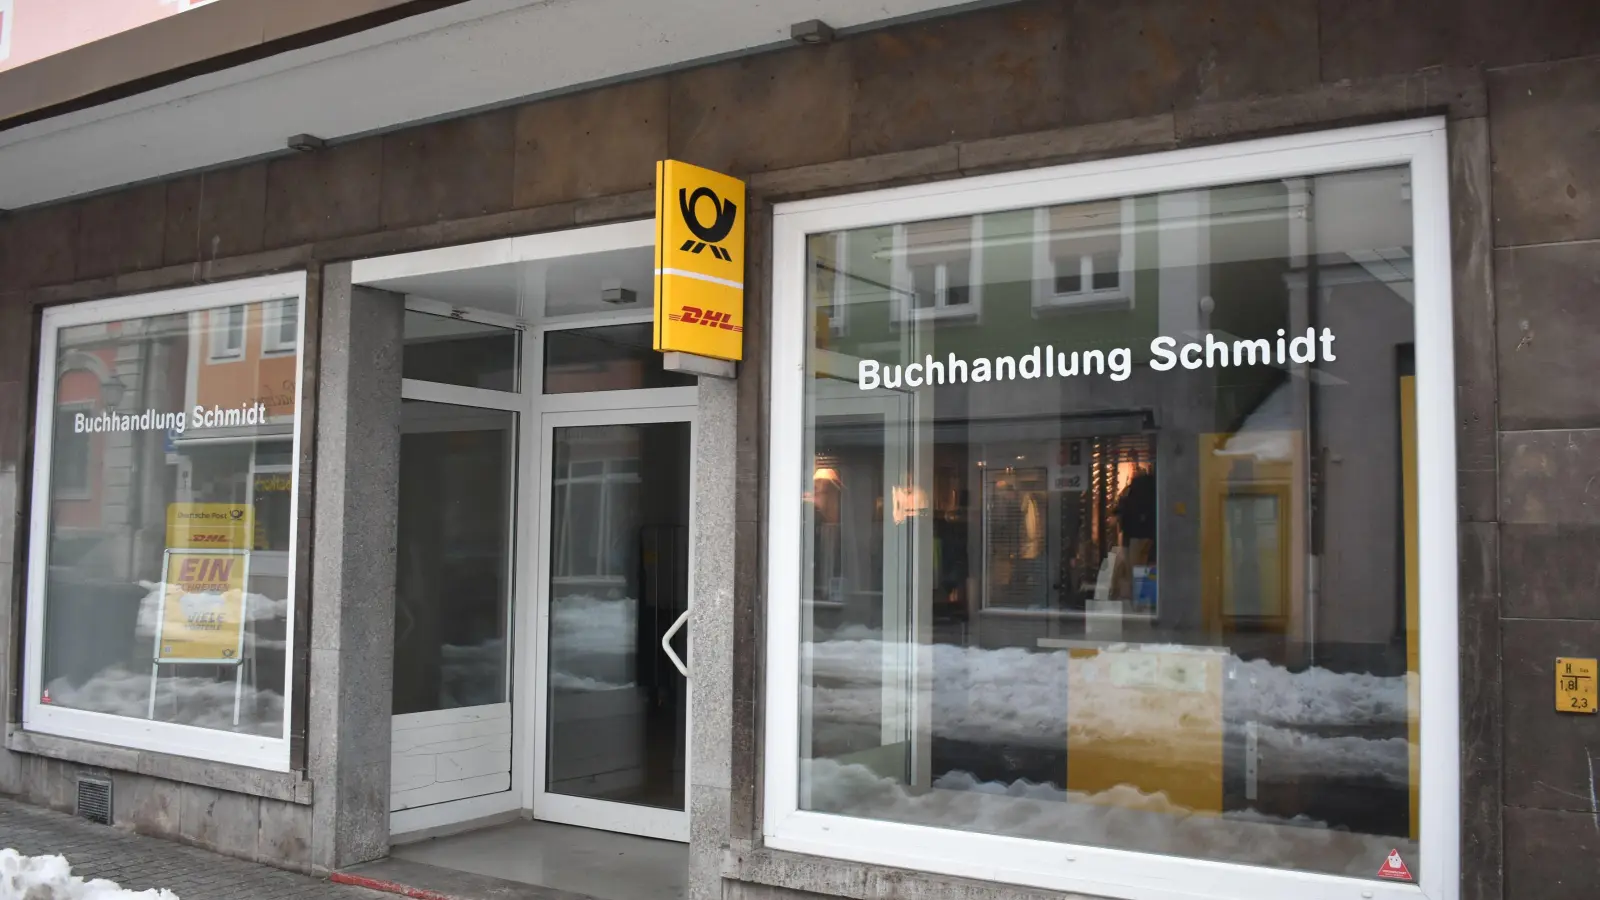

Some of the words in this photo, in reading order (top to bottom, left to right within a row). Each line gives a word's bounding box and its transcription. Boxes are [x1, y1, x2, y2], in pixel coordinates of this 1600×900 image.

[675, 305, 739, 331] DHL
[858, 345, 1132, 391] Buchhandlung
[1149, 327, 1337, 372] Schmidt
[75, 409, 186, 434] Buchhandlung
[192, 402, 266, 428] Schmidt
[211, 512, 227, 520] Post
[190, 534, 230, 542] DHL
[178, 558, 235, 582] EIN
[1566, 663, 1572, 674] H
